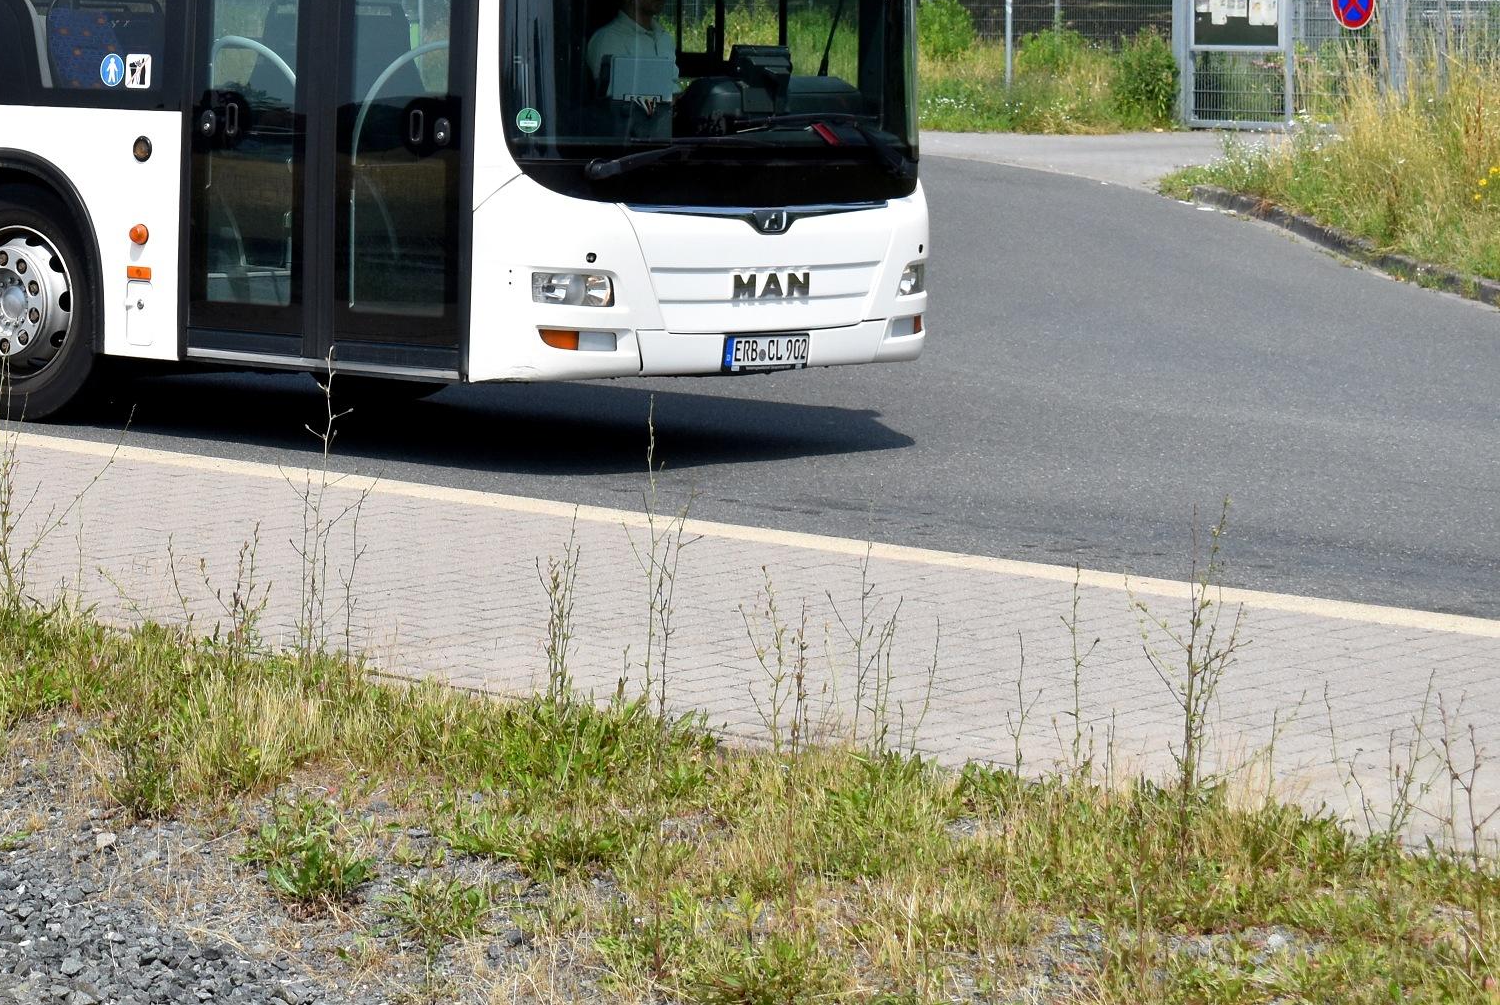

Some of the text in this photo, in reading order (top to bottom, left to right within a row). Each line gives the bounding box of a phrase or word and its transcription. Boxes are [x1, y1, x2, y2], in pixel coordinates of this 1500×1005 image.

[731, 271, 810, 300] MAN
[733, 339, 758, 362] ERB
[767, 339, 782, 361] CL
[786, 338, 807, 361] 902
